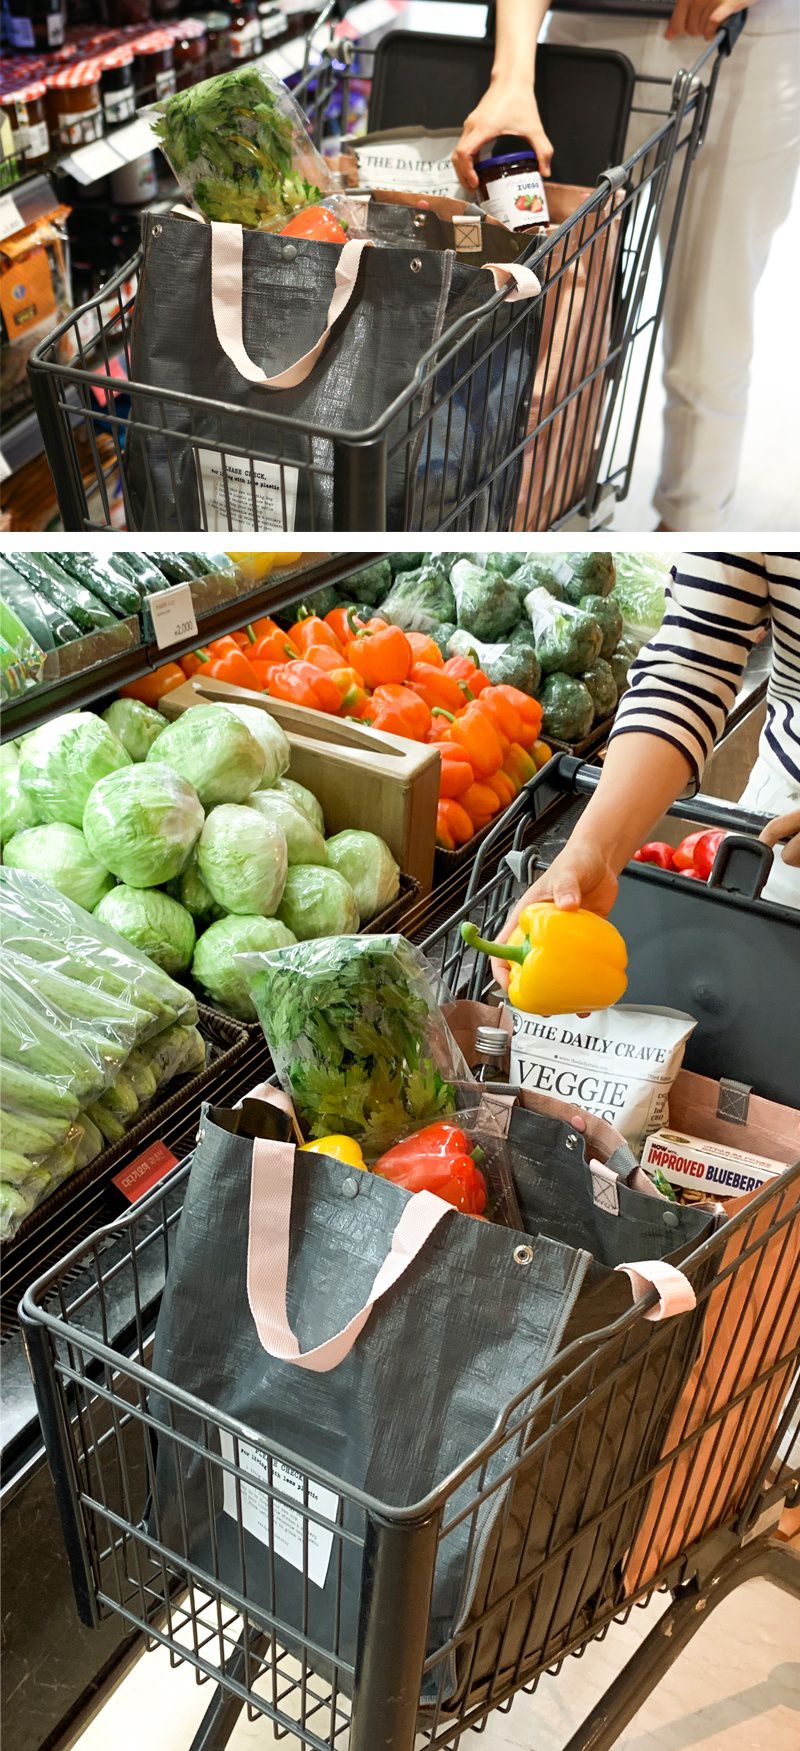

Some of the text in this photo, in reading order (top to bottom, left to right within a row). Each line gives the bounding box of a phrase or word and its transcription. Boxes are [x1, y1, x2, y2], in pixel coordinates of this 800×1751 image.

[367, 156, 393, 169] THE
[396, 158, 434, 172] DAILY
[522, 1019, 668, 1064] THE DAILY CRAVE
[517, 1059, 629, 1108] VEGGIE
[646, 1148, 705, 1179] IMPROVED
[651, 1143, 669, 1154] NOW
